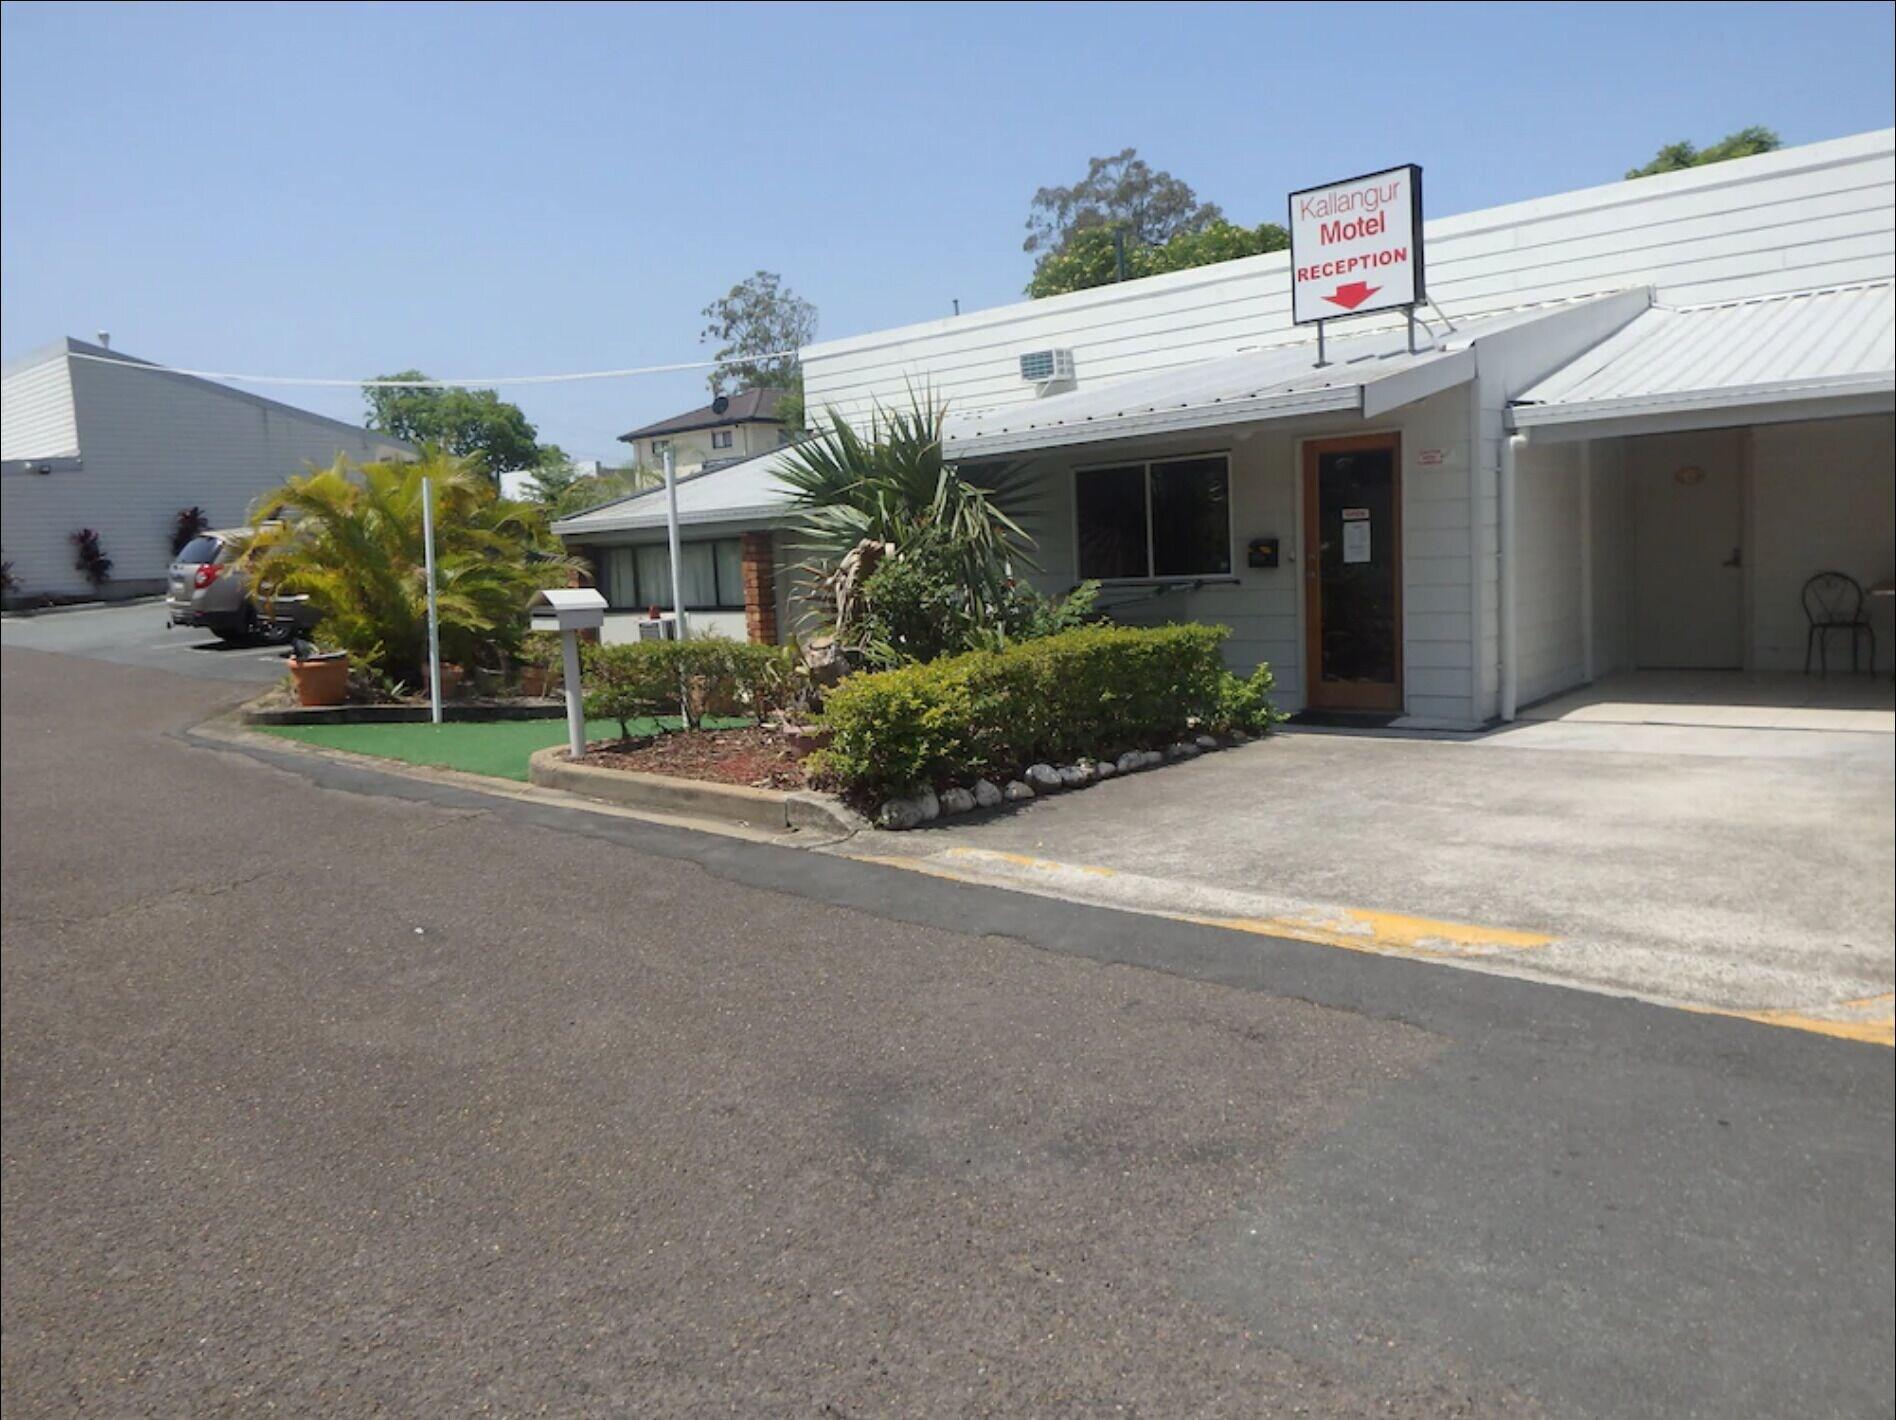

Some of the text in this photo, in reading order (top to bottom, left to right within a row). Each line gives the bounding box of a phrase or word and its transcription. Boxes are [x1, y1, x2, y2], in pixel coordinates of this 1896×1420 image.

[1300, 182, 1400, 221] Kallangur
[1321, 211, 1385, 246] Motel
[1298, 248, 1407, 282] RECEPTION
